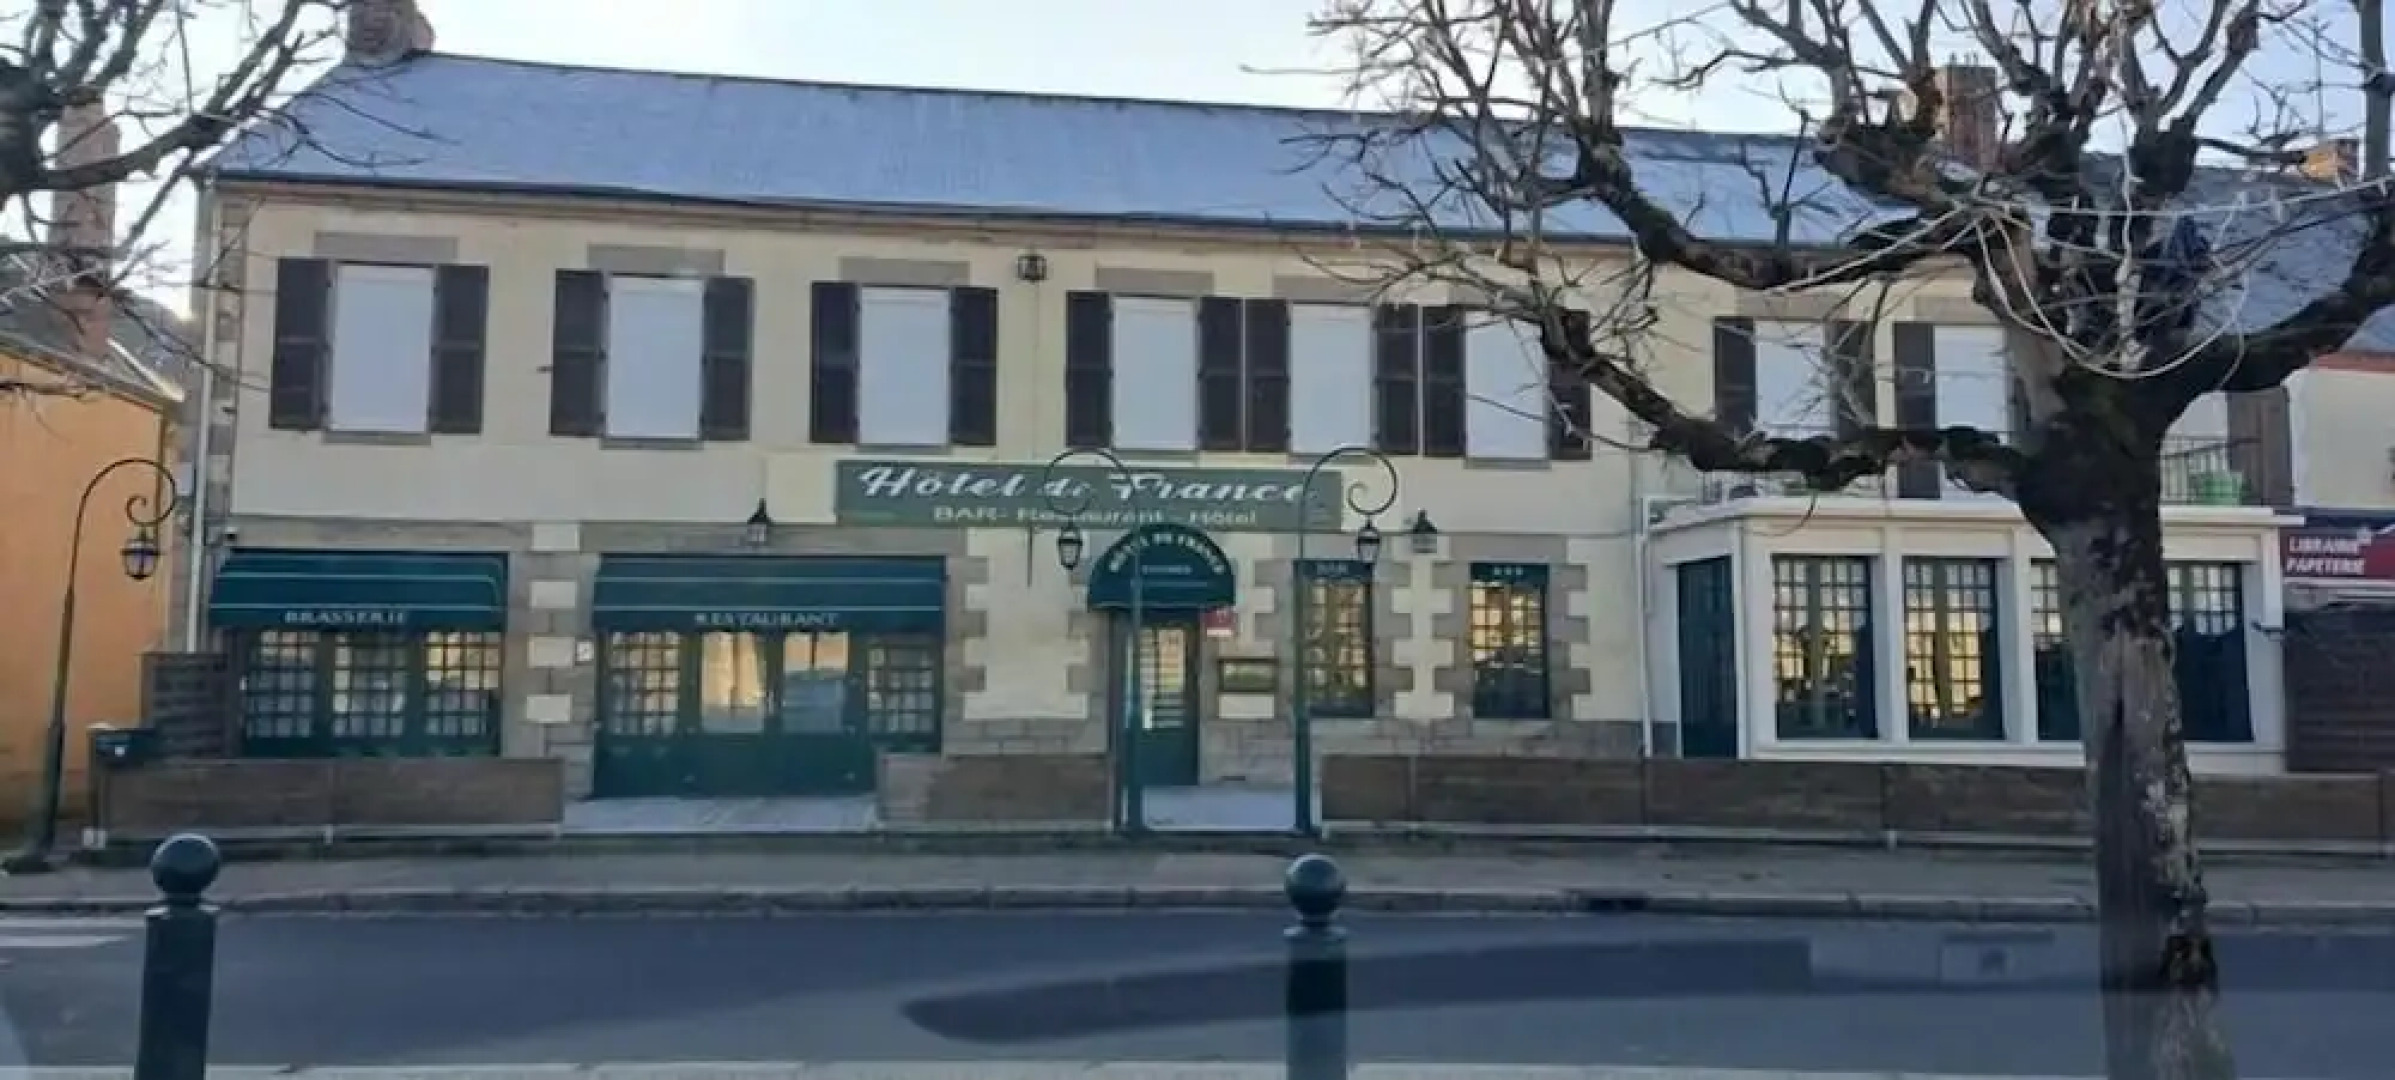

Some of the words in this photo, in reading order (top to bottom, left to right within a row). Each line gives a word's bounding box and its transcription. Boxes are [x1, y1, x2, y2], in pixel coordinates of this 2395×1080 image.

[1107, 473, 1313, 501] France
[284, 609, 405, 624] BRASSERIE
[695, 611, 840, 627] RESTAURANT
